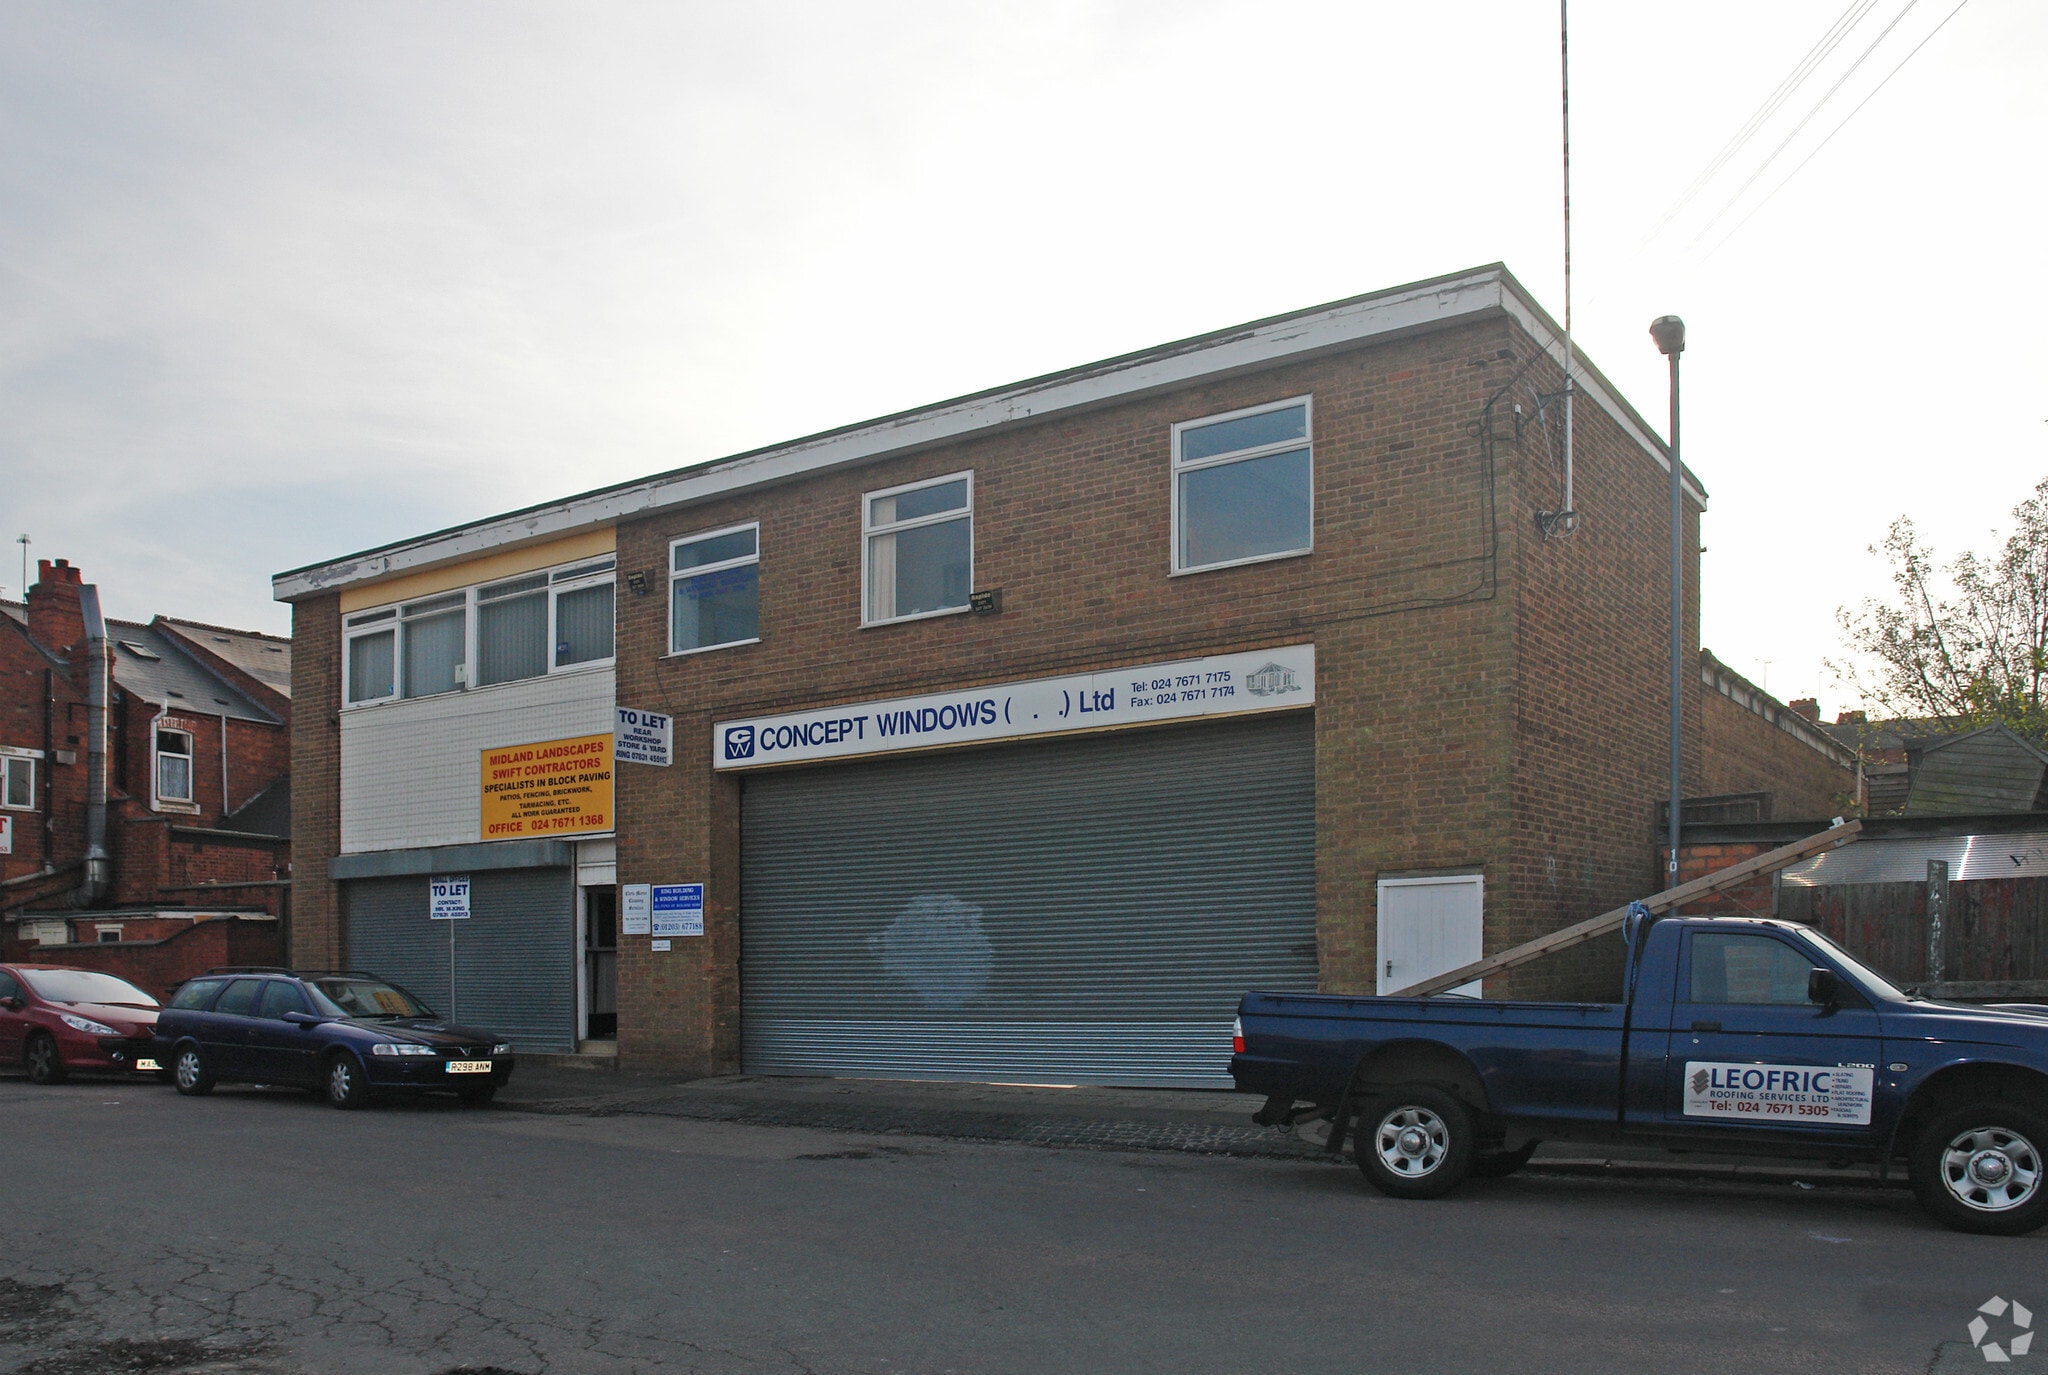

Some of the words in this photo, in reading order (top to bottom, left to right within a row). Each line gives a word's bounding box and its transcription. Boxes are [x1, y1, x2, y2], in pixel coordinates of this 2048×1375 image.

[1131, 682, 1148, 693] Tel:
[1151, 679, 1171, 691] 024
[1175, 675, 1200, 687] 7671
[1206, 671, 1230, 684] 7175
[1130, 696, 1153, 707] Fax:
[1157, 693, 1176, 705] 024
[1181, 690, 1206, 702] 7671
[1210, 686, 1235, 698] 7174
[619, 710, 637, 724] TO
[642, 714, 666, 729] LET
[760, 716, 868, 751] CONCEPT
[877, 700, 996, 737] WINDOWS
[1080, 688, 1114, 713] Ltd
[618, 741, 640, 749] STORE
[624, 734, 661, 744] WORKSHOP
[490, 750, 533, 766] MIDLAND
[537, 742, 604, 760] LANDSCAPES
[616, 750, 630, 758] RING
[493, 767, 522, 780] SWIFT
[525, 758, 600, 775] CONTRACTORS
[485, 780, 534, 793] SPECIALISTS
[537, 779, 546, 787] IN
[548, 776, 576, 786] BLOCK
[579, 772, 610, 782] PAVING
[523, 790, 551, 798] FENCING,
[553, 786, 592, 796] BRICKWORK,
[541, 807, 580, 815] GUARANTEED
[489, 822, 522, 834] OFFICE
[531, 819, 549, 830] 024
[552, 817, 575, 828] 7671
[580, 814, 603, 825] 1368
[432, 886, 446, 896] TO
[450, 885, 467, 896] LET
[451, 1063, 473, 1071] R298
[1711, 1068, 1830, 1093] LEOFRIC
[1710, 1091, 1754, 1099] ROOFING
[1759, 1093, 1806, 1102] SERVICES
[1710, 1100, 1732, 1111] Tel:
[1737, 1102, 1759, 1112] 024
[1766, 1104, 1793, 1114] 7671
[1798, 1105, 1829, 1116] 5305
